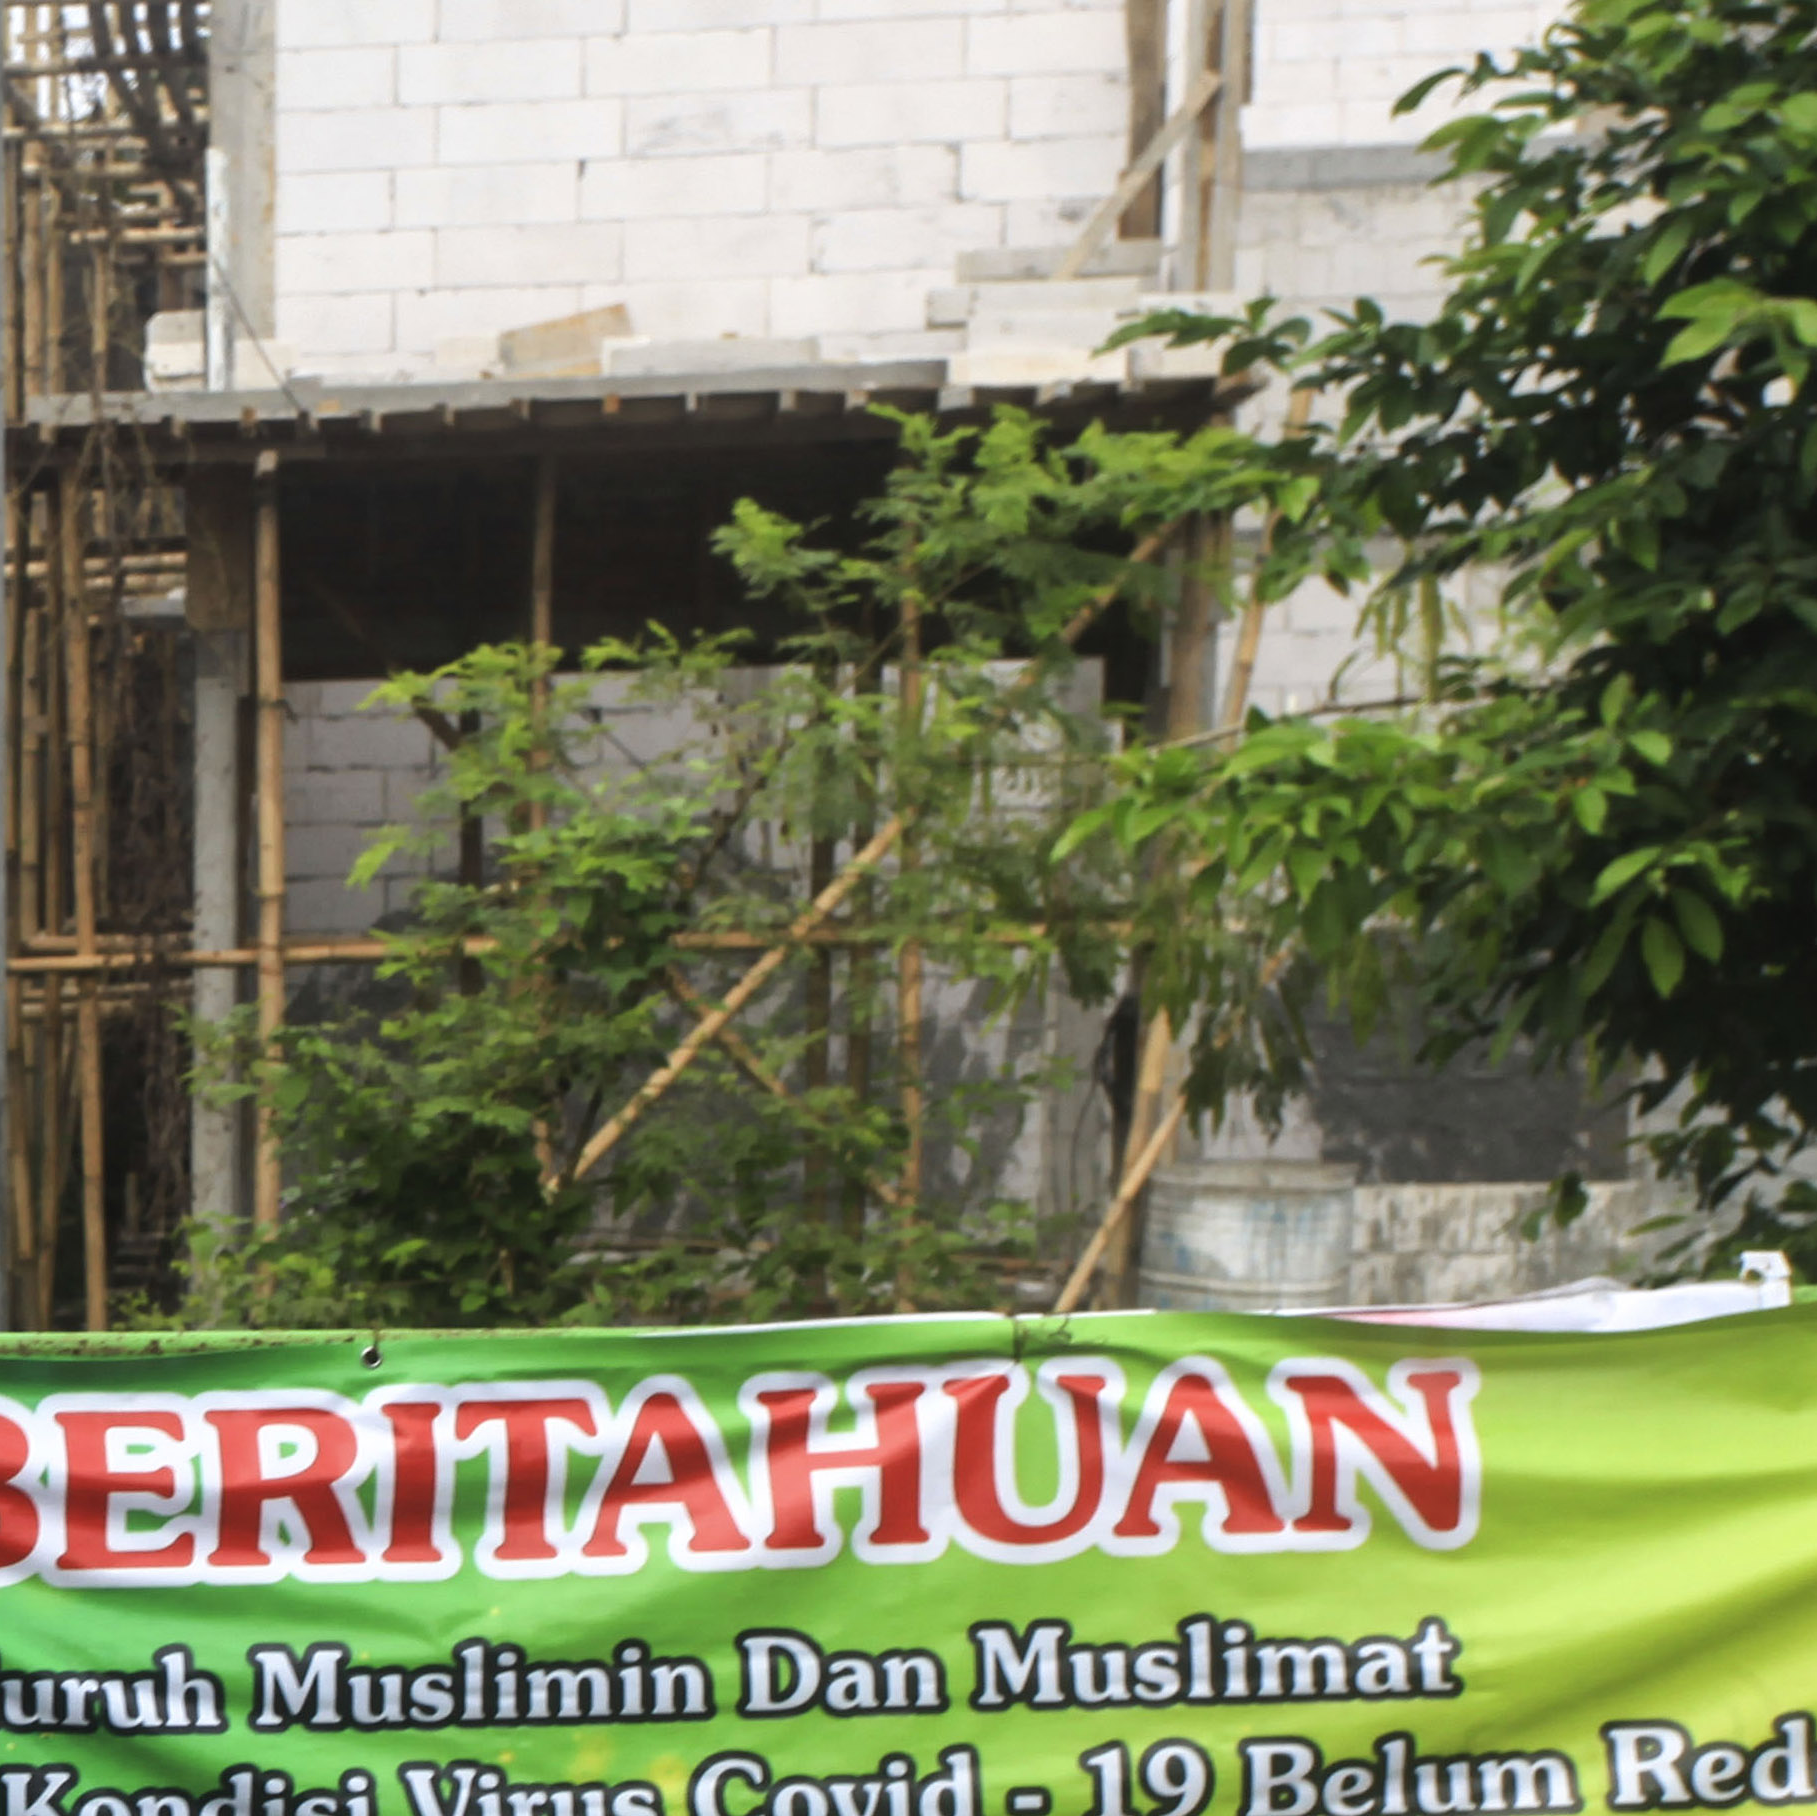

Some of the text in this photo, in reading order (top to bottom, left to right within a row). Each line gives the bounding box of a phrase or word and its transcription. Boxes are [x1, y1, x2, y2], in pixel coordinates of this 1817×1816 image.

[251, 1636, 709, 1734] Muslimin
[737, 1627, 946, 1718] Dan
[970, 1613, 1460, 1709] Muslimat
